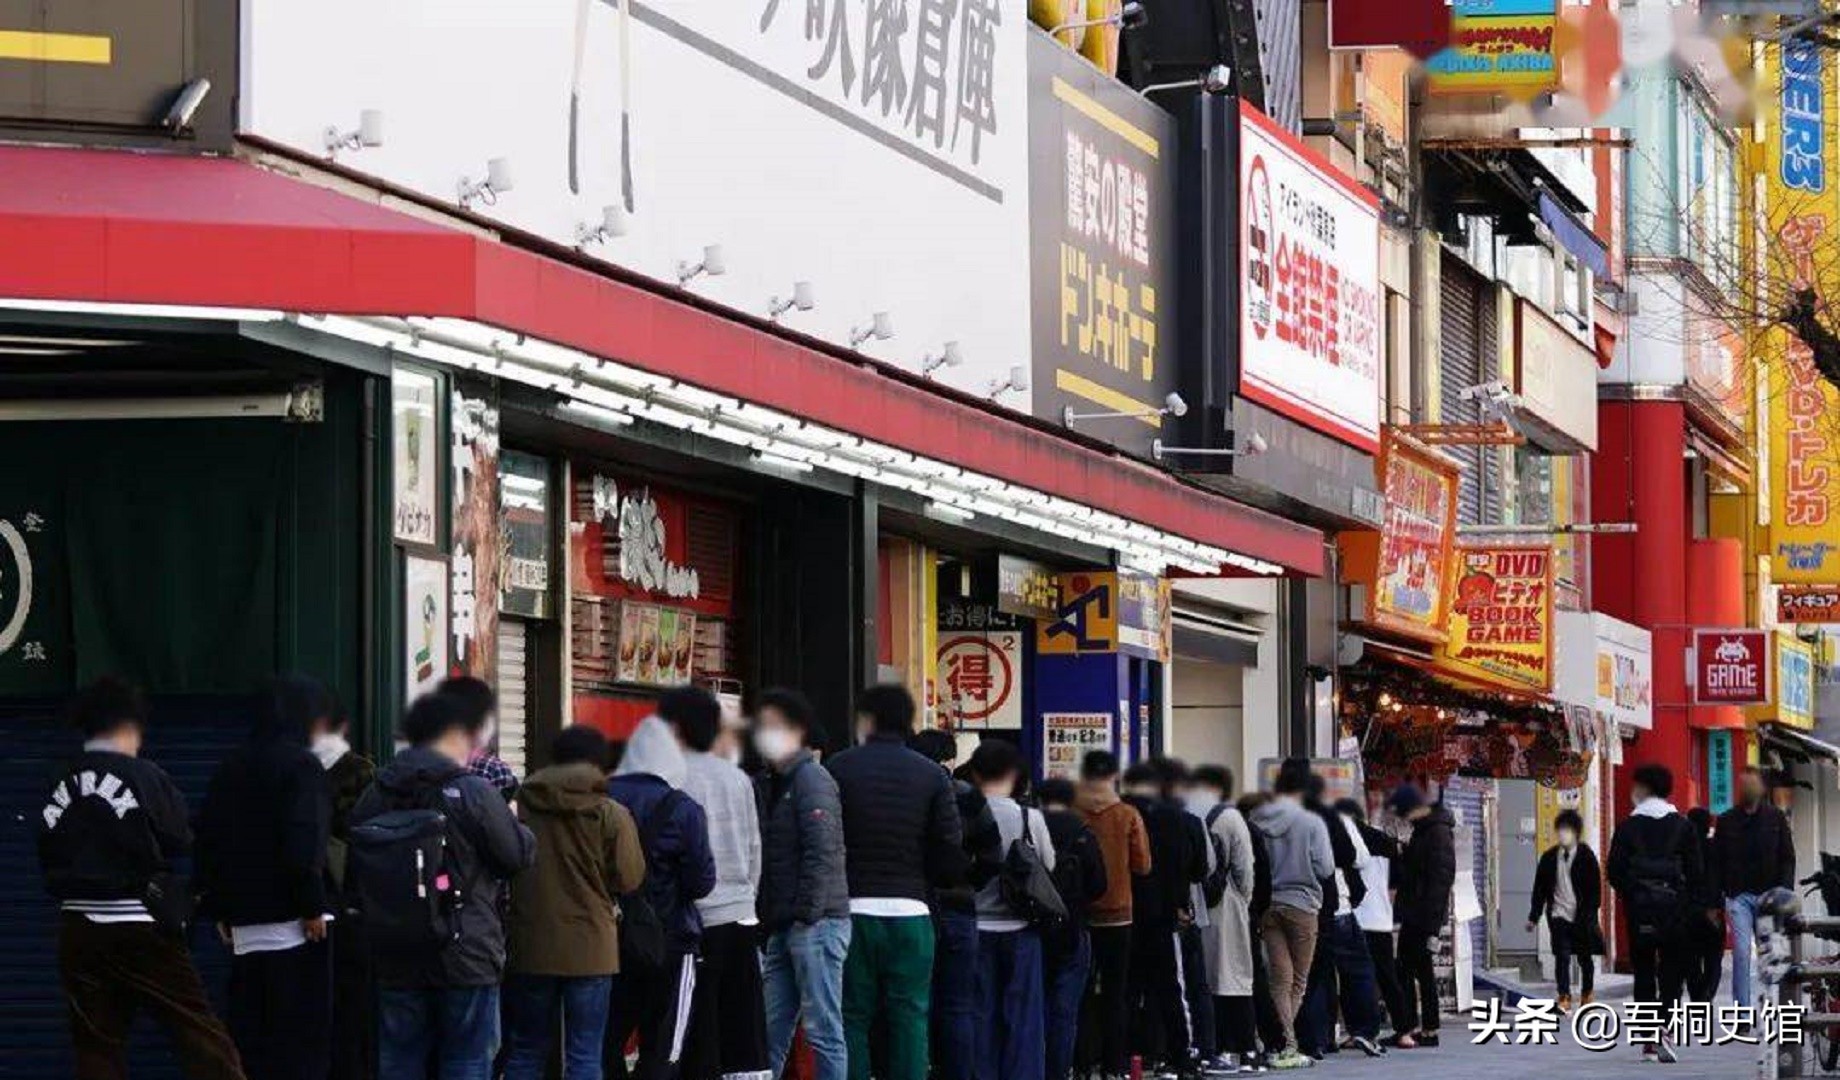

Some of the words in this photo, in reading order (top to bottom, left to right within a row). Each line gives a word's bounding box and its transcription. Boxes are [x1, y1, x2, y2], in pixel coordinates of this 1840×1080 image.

[1496, 553, 1544, 577] DVD
[1492, 579, 1544, 604] ビデオ
[1781, 594, 1839, 608] フィギュア
[1467, 605, 1542, 625] BOOK
[1467, 626, 1542, 643] GAME
[946, 653, 993, 700] 得
[1002, 635, 1014, 651] 2
[1706, 663, 1758, 688] GAME
